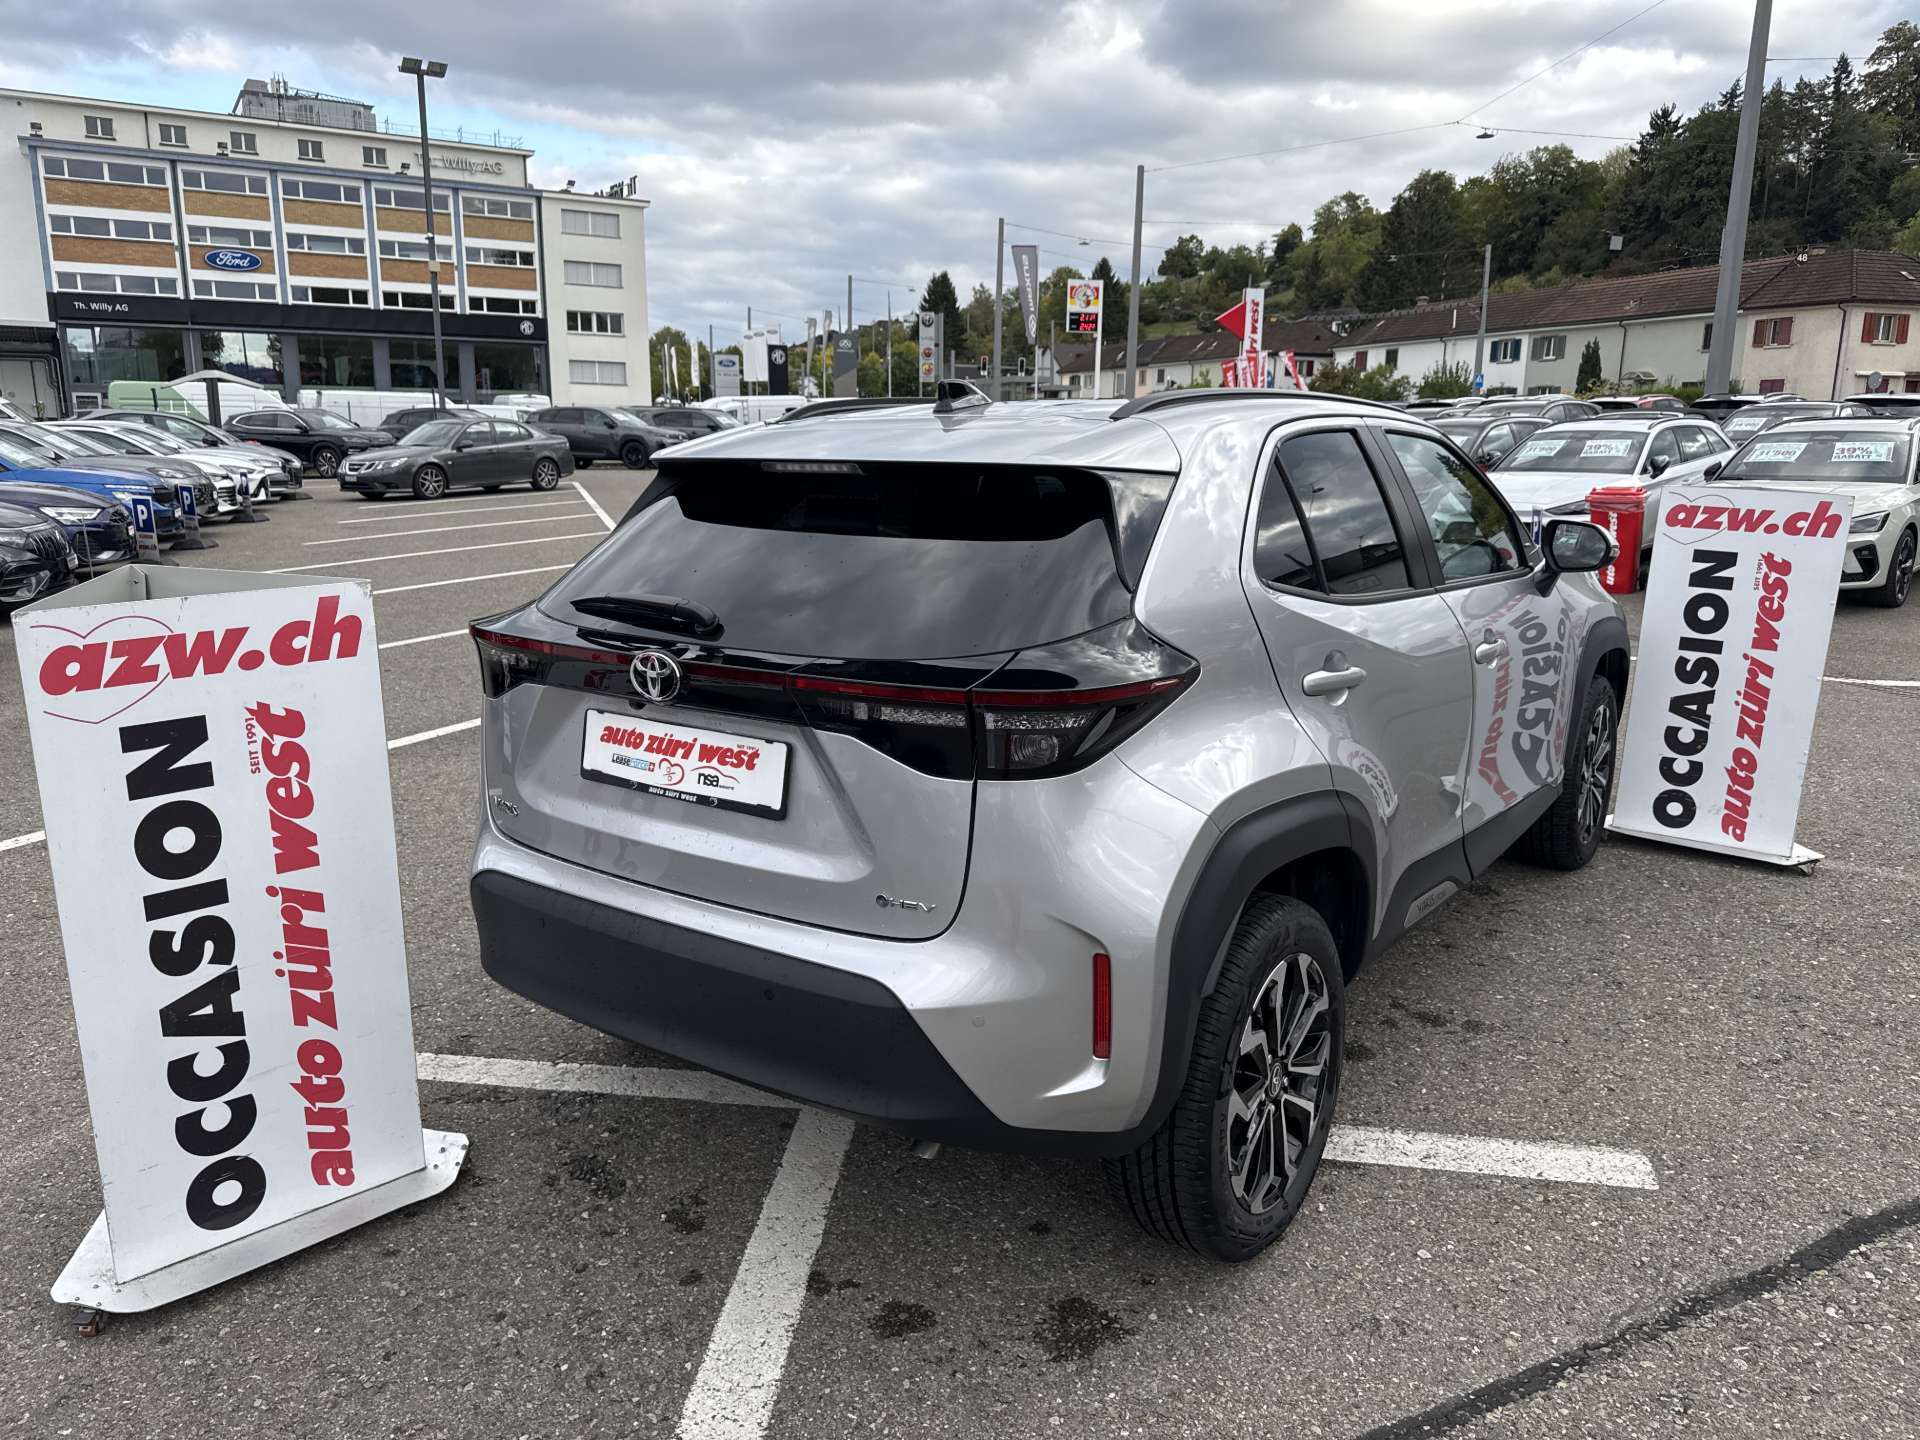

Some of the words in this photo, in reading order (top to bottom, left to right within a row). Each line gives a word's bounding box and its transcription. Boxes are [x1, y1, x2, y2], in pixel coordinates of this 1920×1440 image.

[443, 152, 477, 174] Willy
[481, 159, 504, 175] AG
[216, 251, 250, 267] Ford
[1796, 253, 1808, 262] 48
[73, 302, 88, 310] Th.
[90, 303, 112, 312] Willy
[114, 304, 129, 312] AG
[771, 349, 785, 364] MG
[1835, 446, 1873, 455] 39%
[182, 491, 190, 510] P
[137, 504, 147, 527] P
[1665, 501, 1842, 538] azw.ch
[1755, 559, 1764, 575] 1991
[1753, 577, 1761, 591] SEIT
[1751, 551, 1792, 651] west
[39, 595, 362, 696] azw.ch
[1653, 549, 1738, 829] OCCASION
[1734, 653, 1774, 749] züri
[245, 717, 257, 745] 1991
[600, 725, 644, 750] auto
[643, 732, 697, 760] züri
[698, 743, 760, 771] west
[249, 751, 261, 775] SEIT
[244, 701, 321, 874] west
[698, 772, 719, 788] nsa
[648, 786, 664, 795] auto
[680, 792, 698, 802] west
[1721, 747, 1757, 842] auto
[264, 884, 339, 1032] züri
[119, 714, 268, 1231] OCCASION
[288, 1037, 355, 1190] auto
